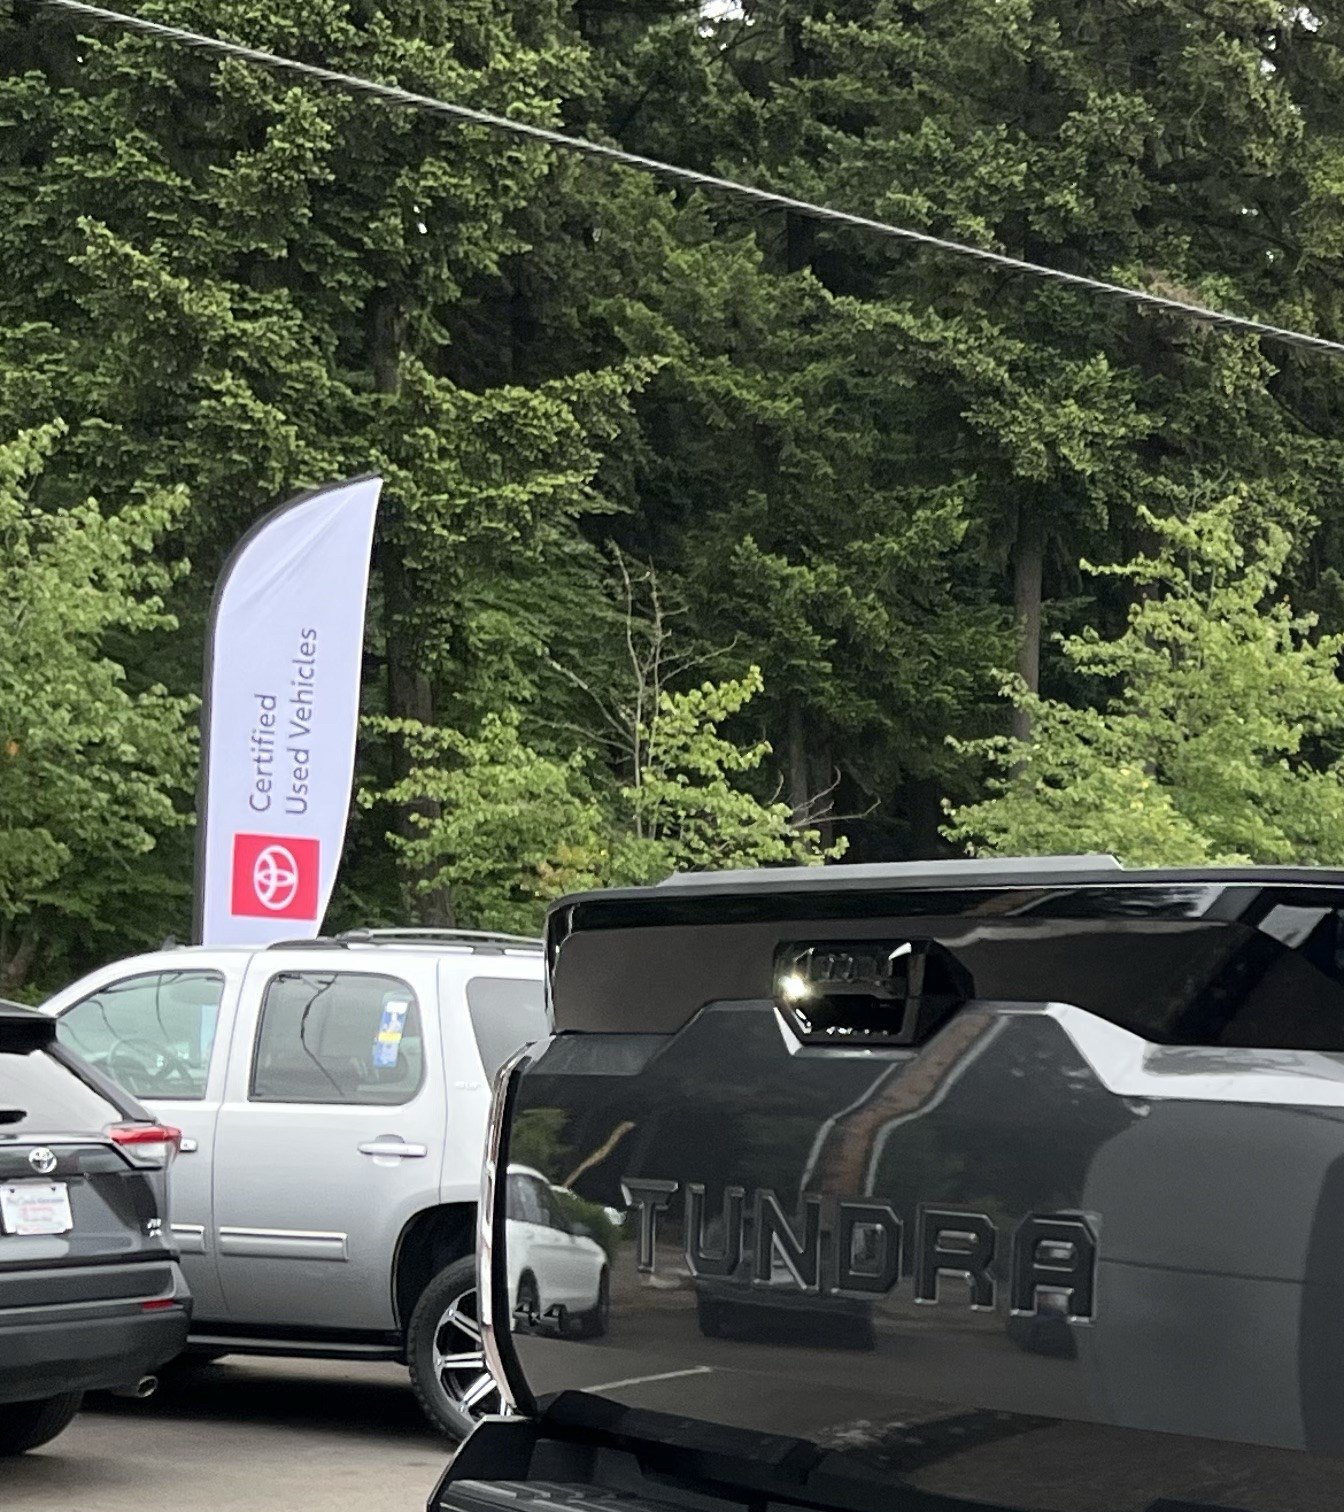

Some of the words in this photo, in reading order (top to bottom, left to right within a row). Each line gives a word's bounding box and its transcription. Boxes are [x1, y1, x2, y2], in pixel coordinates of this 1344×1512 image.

[288, 627, 317, 739] Vehicles
[248, 692, 277, 812] Certified
[285, 748, 310, 815] Used
[619, 1176, 1100, 1323] TUNDRA
